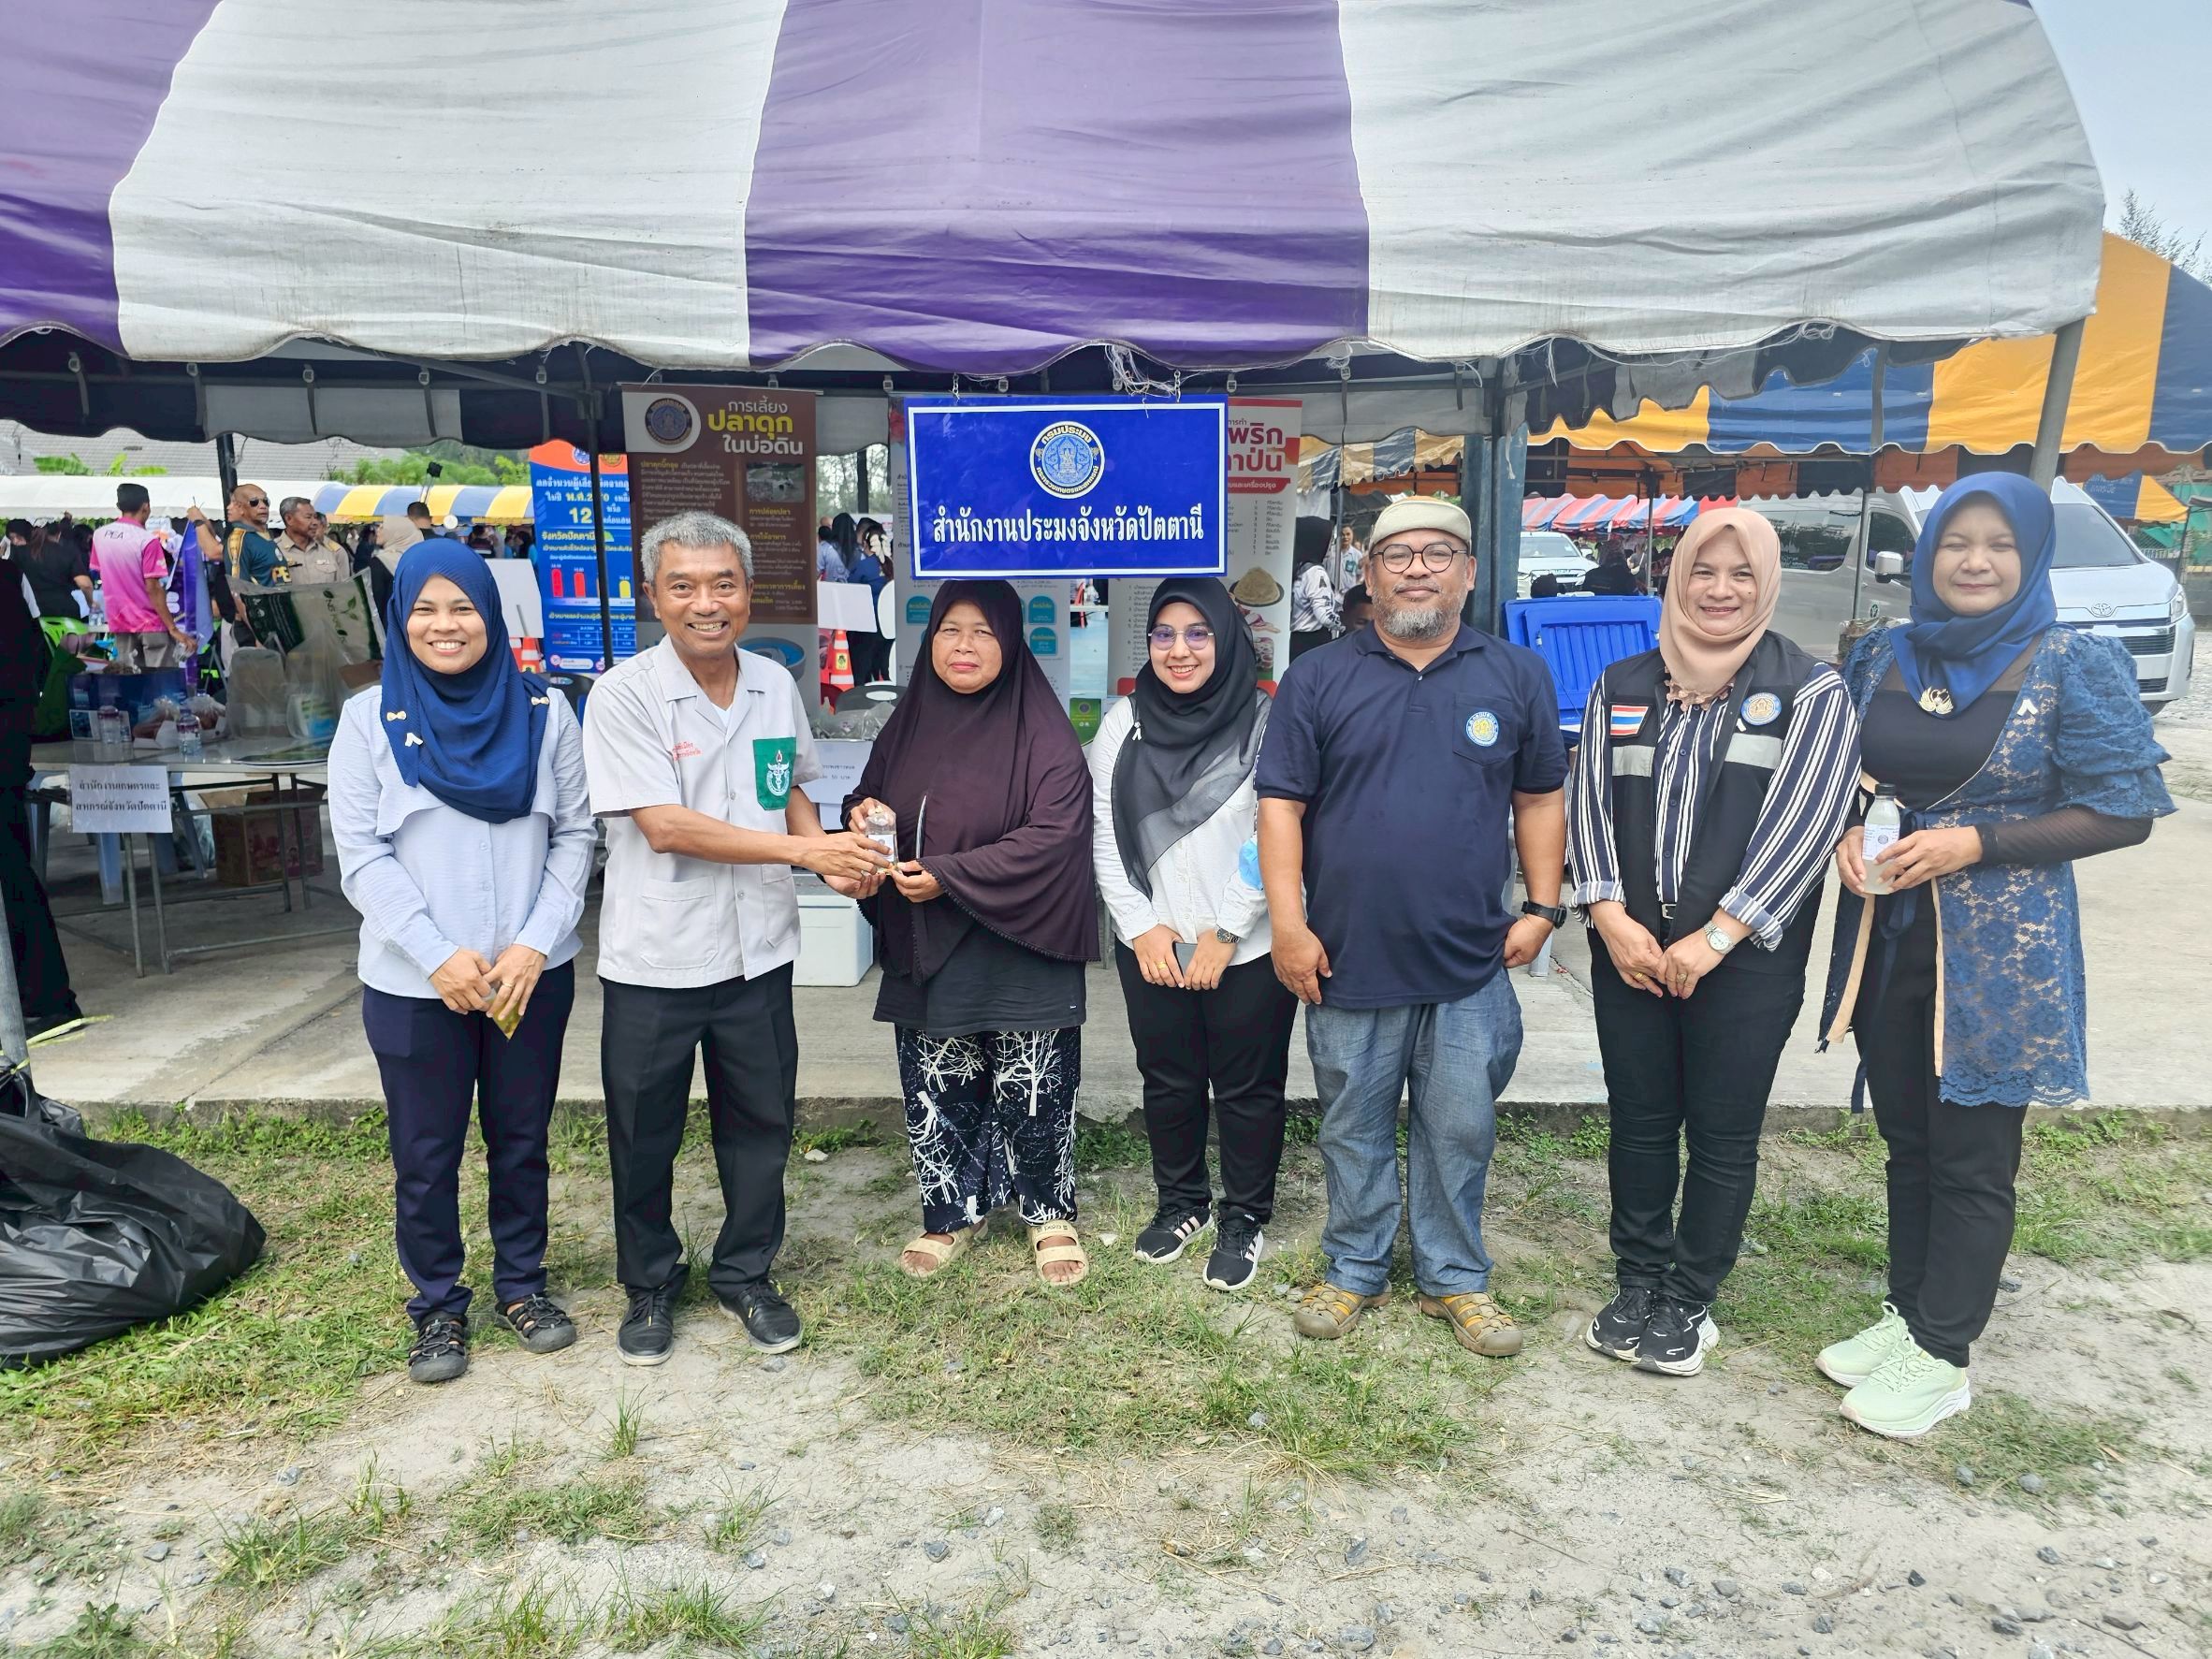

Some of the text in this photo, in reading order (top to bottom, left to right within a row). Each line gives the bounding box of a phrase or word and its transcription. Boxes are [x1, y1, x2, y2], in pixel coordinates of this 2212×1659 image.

[728, 395, 788, 414] การเลี้ยง
[708, 409, 793, 441] ปลาดุก
[1041, 425, 1092, 444] กรมประมง
[721, 433, 804, 455] ในบ่อดิน
[933, 502, 1204, 543] สำนักงานประมงจังหวัดปัตตานี
